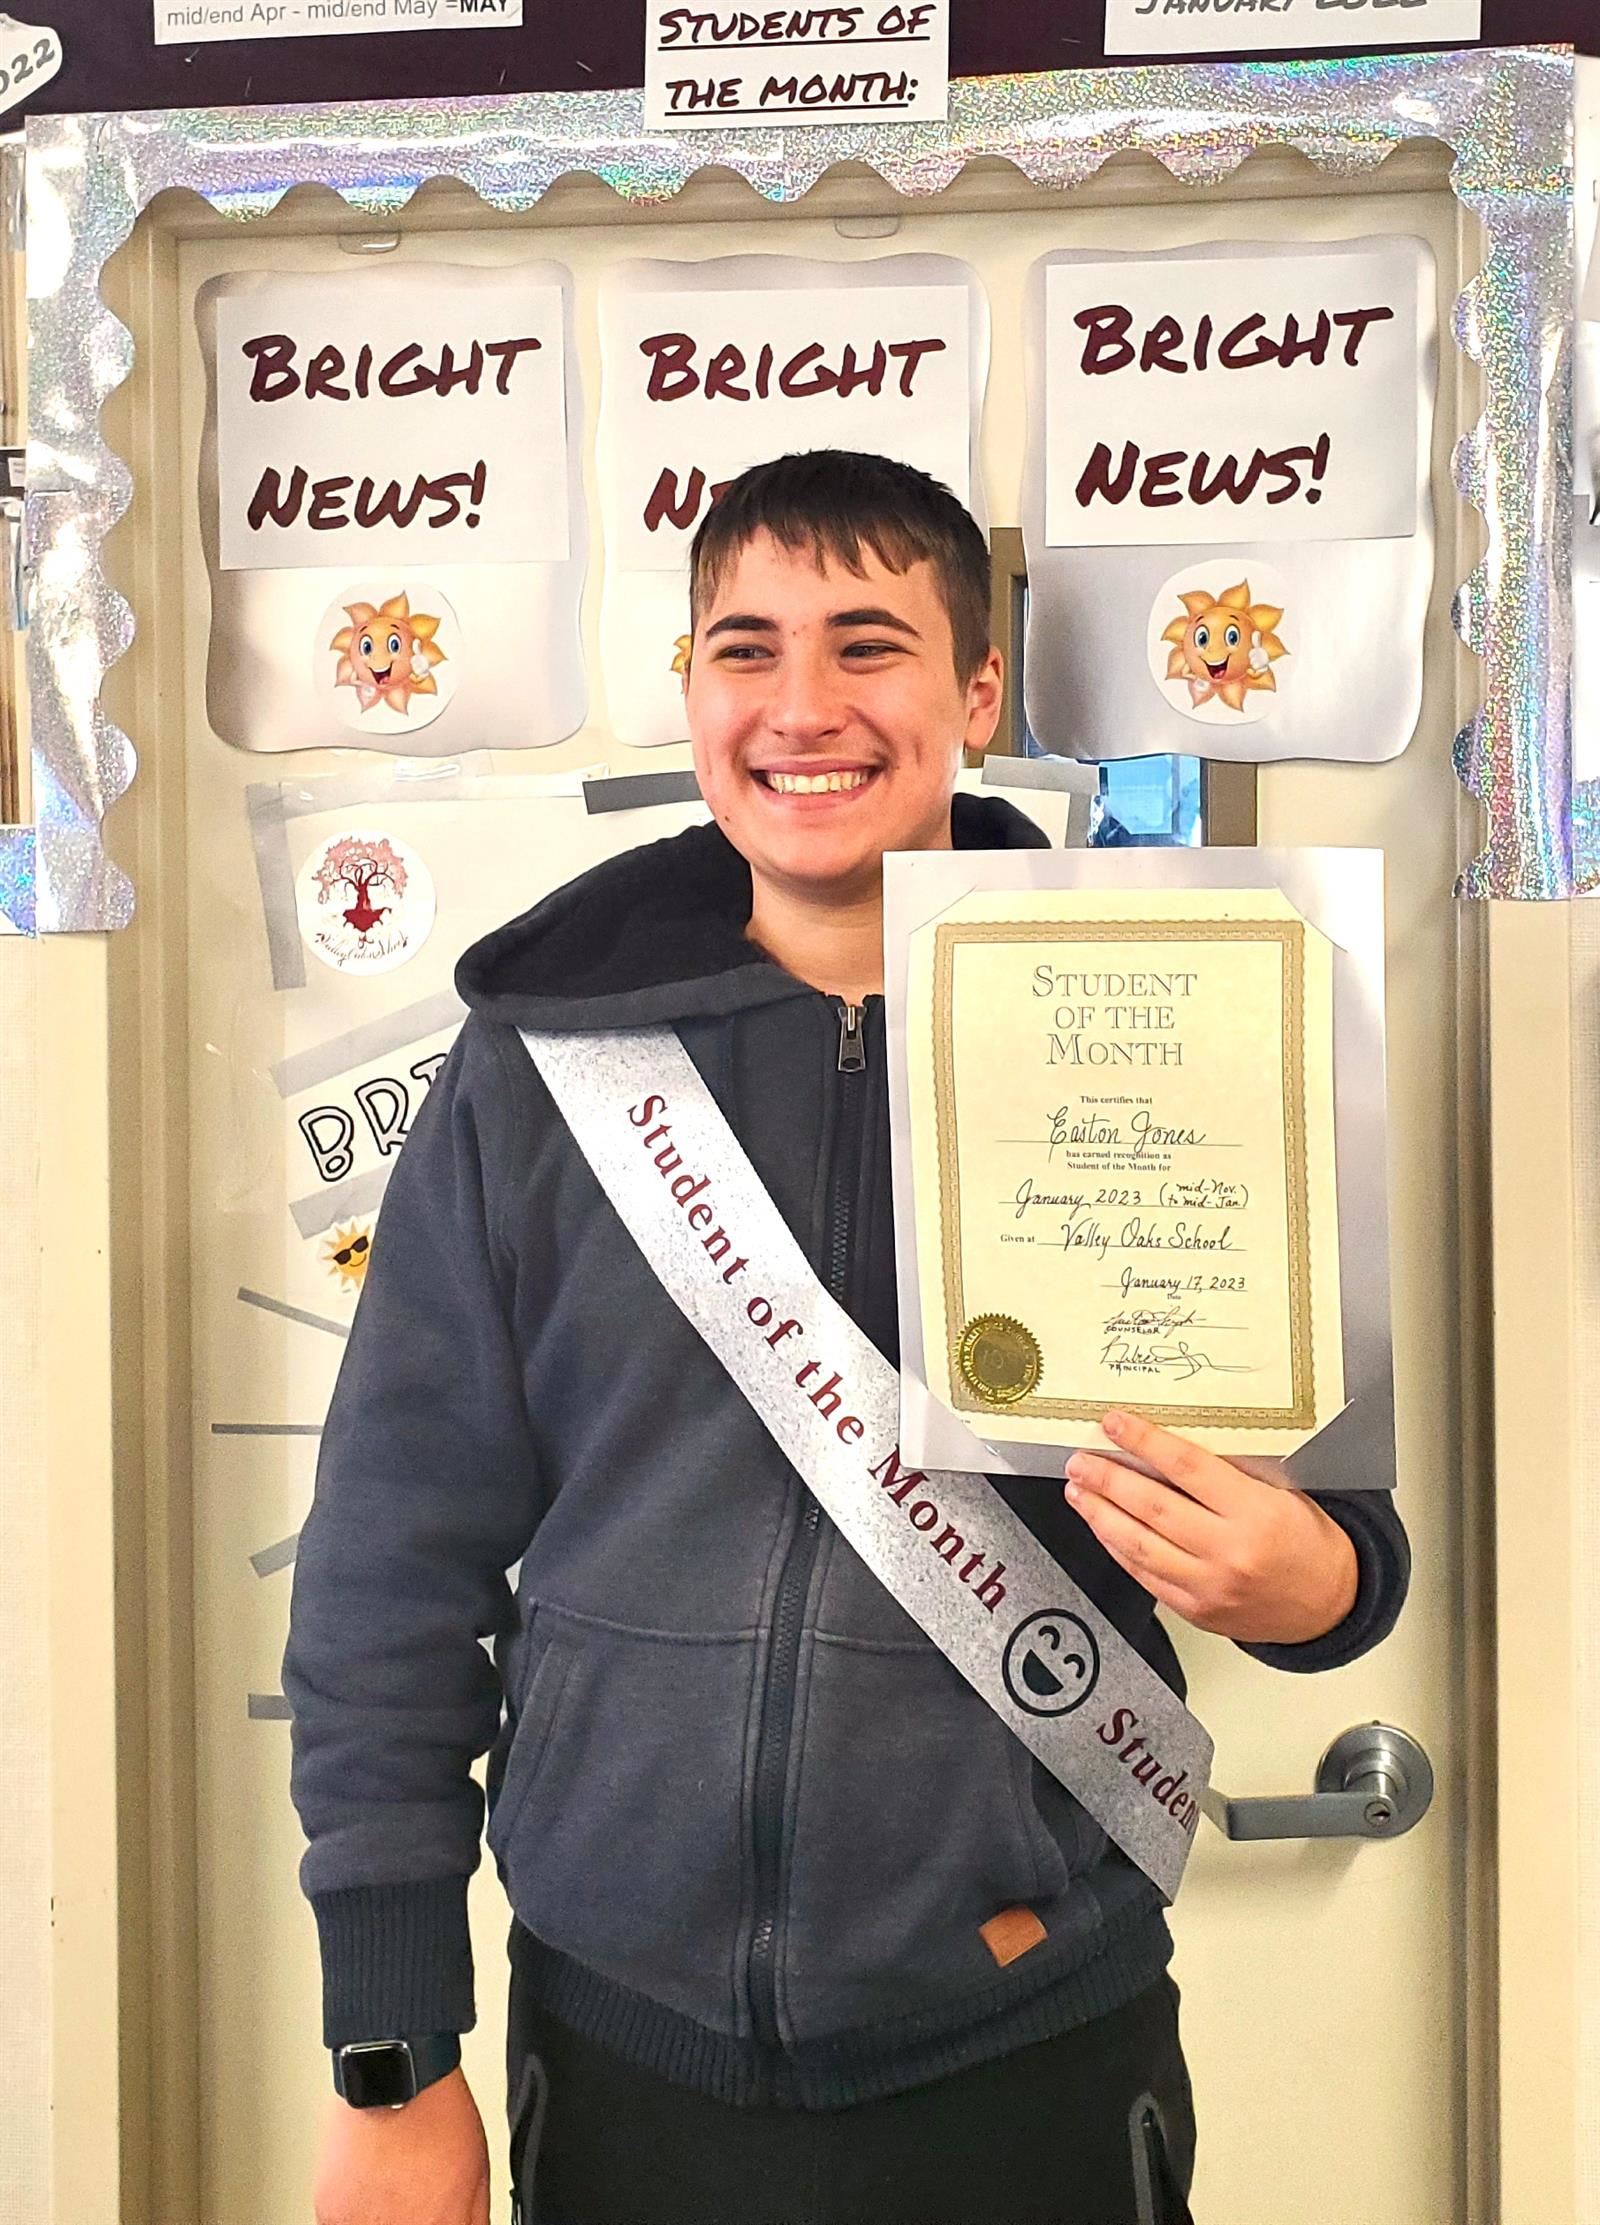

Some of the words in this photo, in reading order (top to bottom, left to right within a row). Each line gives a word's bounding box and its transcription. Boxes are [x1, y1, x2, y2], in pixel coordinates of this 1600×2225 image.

[167, 6, 243, 26] mid/end
[250, 4, 286, 25] Apr
[307, 0, 386, 18] mid/end
[394, 0, 437, 19] May
[659, 8, 864, 44] STUDENTS
[877, 4, 937, 35] OF
[666, 78, 743, 109] THE
[759, 71, 918, 106] MONTH:
[1073, 303, 1394, 376] BRIGHT
[242, 334, 541, 402] BRIGHT
[639, 332, 947, 402] BRIGHT
[1074, 432, 1331, 507] NEWS!
[247, 459, 486, 531] NEWS!
[1032, 965, 1198, 997] STUDENT
[1055, 1006, 1096, 1030] OF
[1104, 1006, 1176, 1030] THE
[1045, 1033, 1183, 1066] MONTH
[1080, 1095, 1098, 1105] This
[1100, 1095, 1133, 1105] certifies
[1135, 1096, 1153, 1105] that
[1047, 1106, 1121, 1162] Easton
[1131, 1110, 1206, 1153] Jones
[1066, 1150, 1080, 1158] has
[1082, 1150, 1111, 1159] earned
[1113, 1151, 1160, 1160] recognition
[1163, 1152, 1172, 1160] as
[1067, 1161, 1099, 1171] Student
[1101, 1162, 1111, 1171] of
[1112, 1162, 1126, 1171] the
[1128, 1163, 1156, 1172] Month
[1158, 1163, 1172, 1172] for
[1015, 1178, 1091, 1220] January
[1095, 1189, 1142, 1206] 2023
[1000, 1233, 1025, 1243] Given
[1027, 1234, 1036, 1243] at
[1061, 1218, 1111, 1261] Valley
[1120, 1217, 1162, 1248] Oaks
[1168, 1222, 1233, 1250] School
[1121, 1266, 1182, 1298] January
[1209, 1276, 1246, 1290] 2023
[1104, 1325, 1162, 1335] COUNSELOR
[627, 1095, 749, 1285] Student
[747, 1297, 804, 1352] of
[795, 1360, 865, 1445] the
[867, 1443, 1007, 1615] Month
[1108, 1363, 1161, 1377] PRINCIPAL
